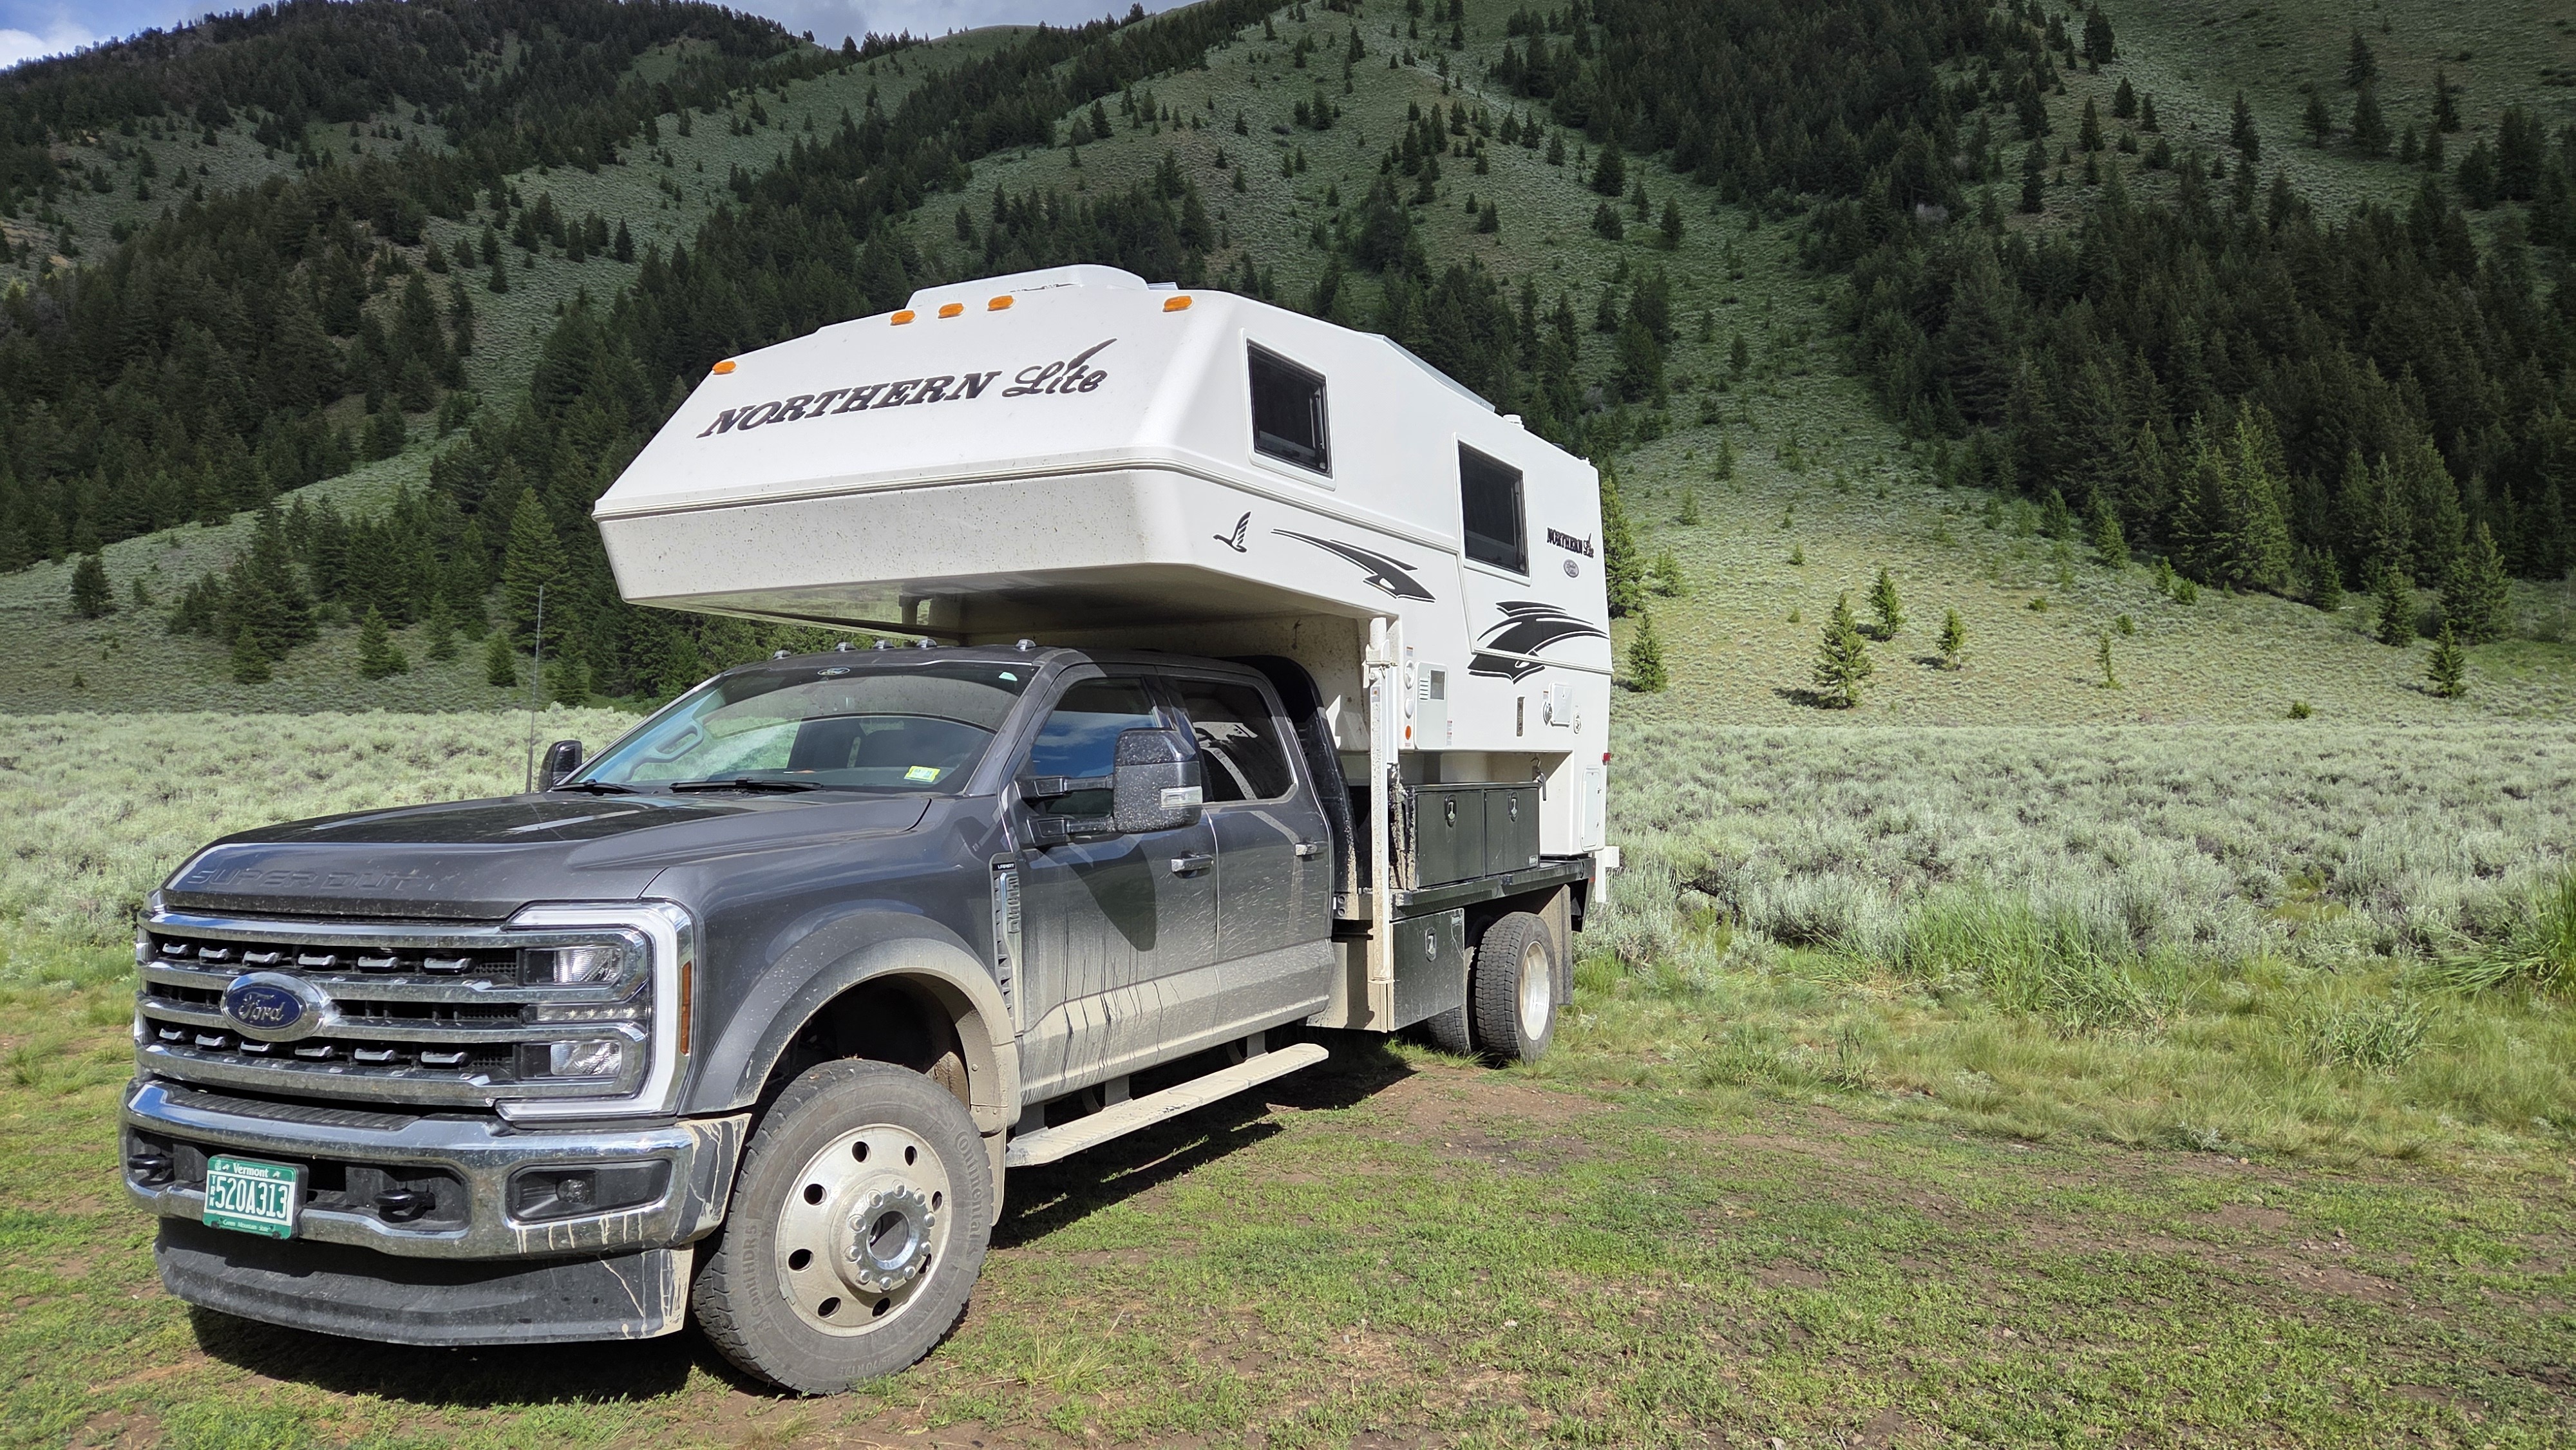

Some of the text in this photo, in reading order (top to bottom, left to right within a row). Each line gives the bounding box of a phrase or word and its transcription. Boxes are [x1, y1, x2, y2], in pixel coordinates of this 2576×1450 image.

[696, 338, 1117, 438] NORTHERN Lite
[1546, 527, 1583, 555] NORTHERN
[187, 868, 319, 889] SUPER
[238, 992, 285, 1022] Ford
[232, 1162, 269, 1178] Vermont
[954, 1131, 983, 1239] Continental
[215, 1176, 288, 1218] 520A313
